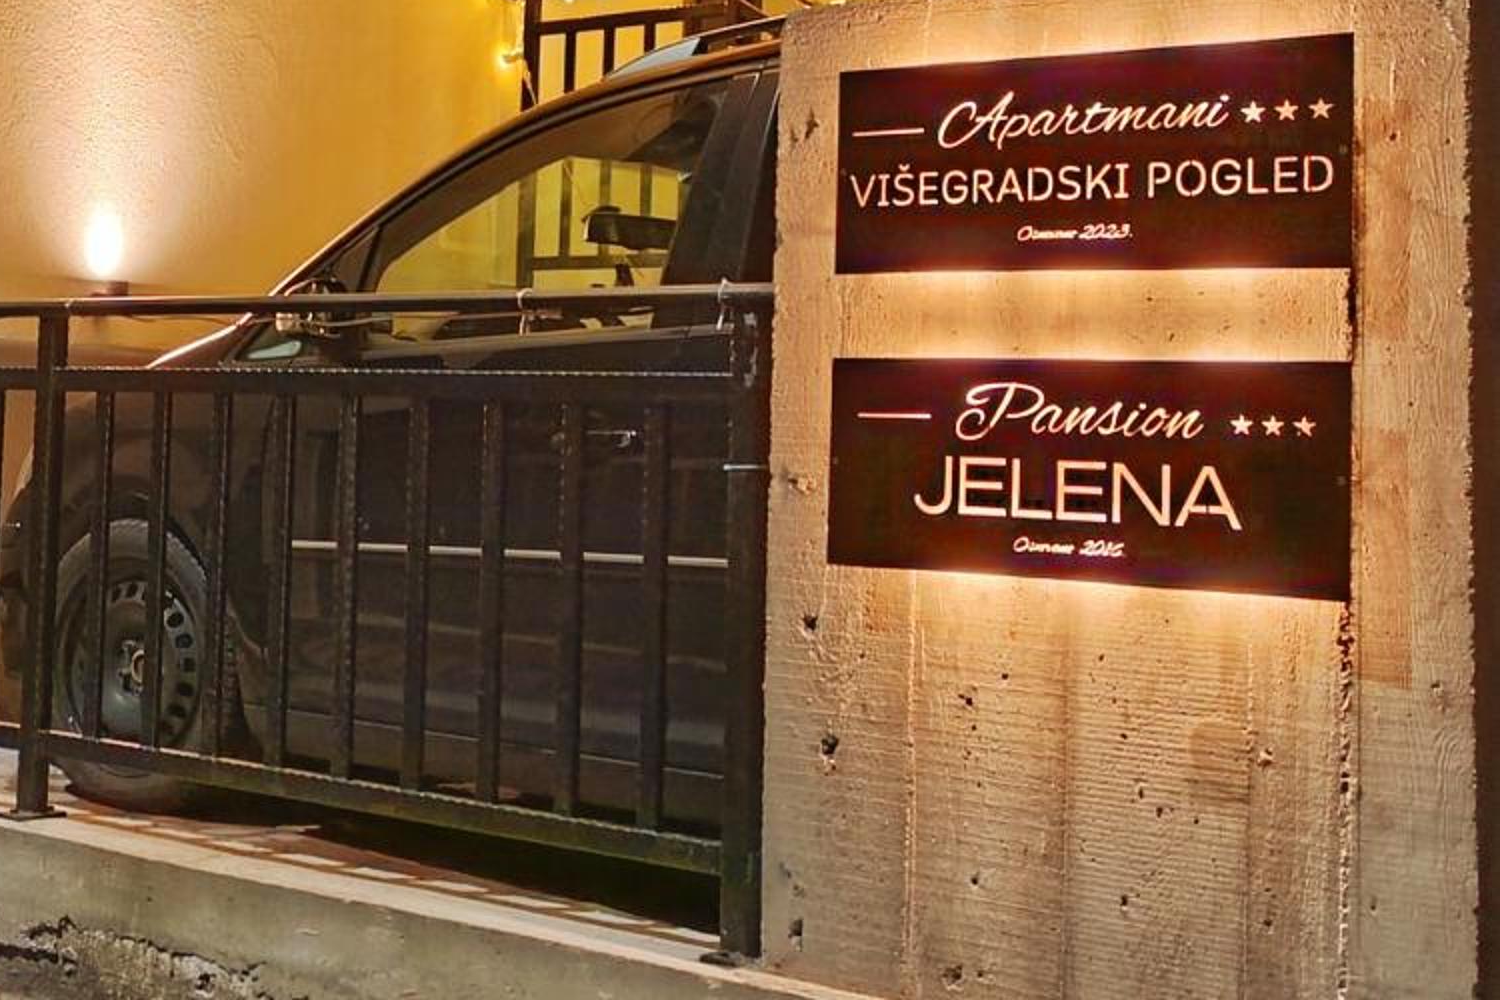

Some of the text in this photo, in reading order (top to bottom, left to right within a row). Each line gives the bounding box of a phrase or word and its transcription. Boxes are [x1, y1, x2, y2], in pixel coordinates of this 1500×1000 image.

[937, 91, 1230, 150] Apartmani
[850, 155, 1334, 207] VIŠEGRADSKI POGLED
[955, 382, 1204, 441] Pansion
[914, 455, 1242, 531] JELENA
